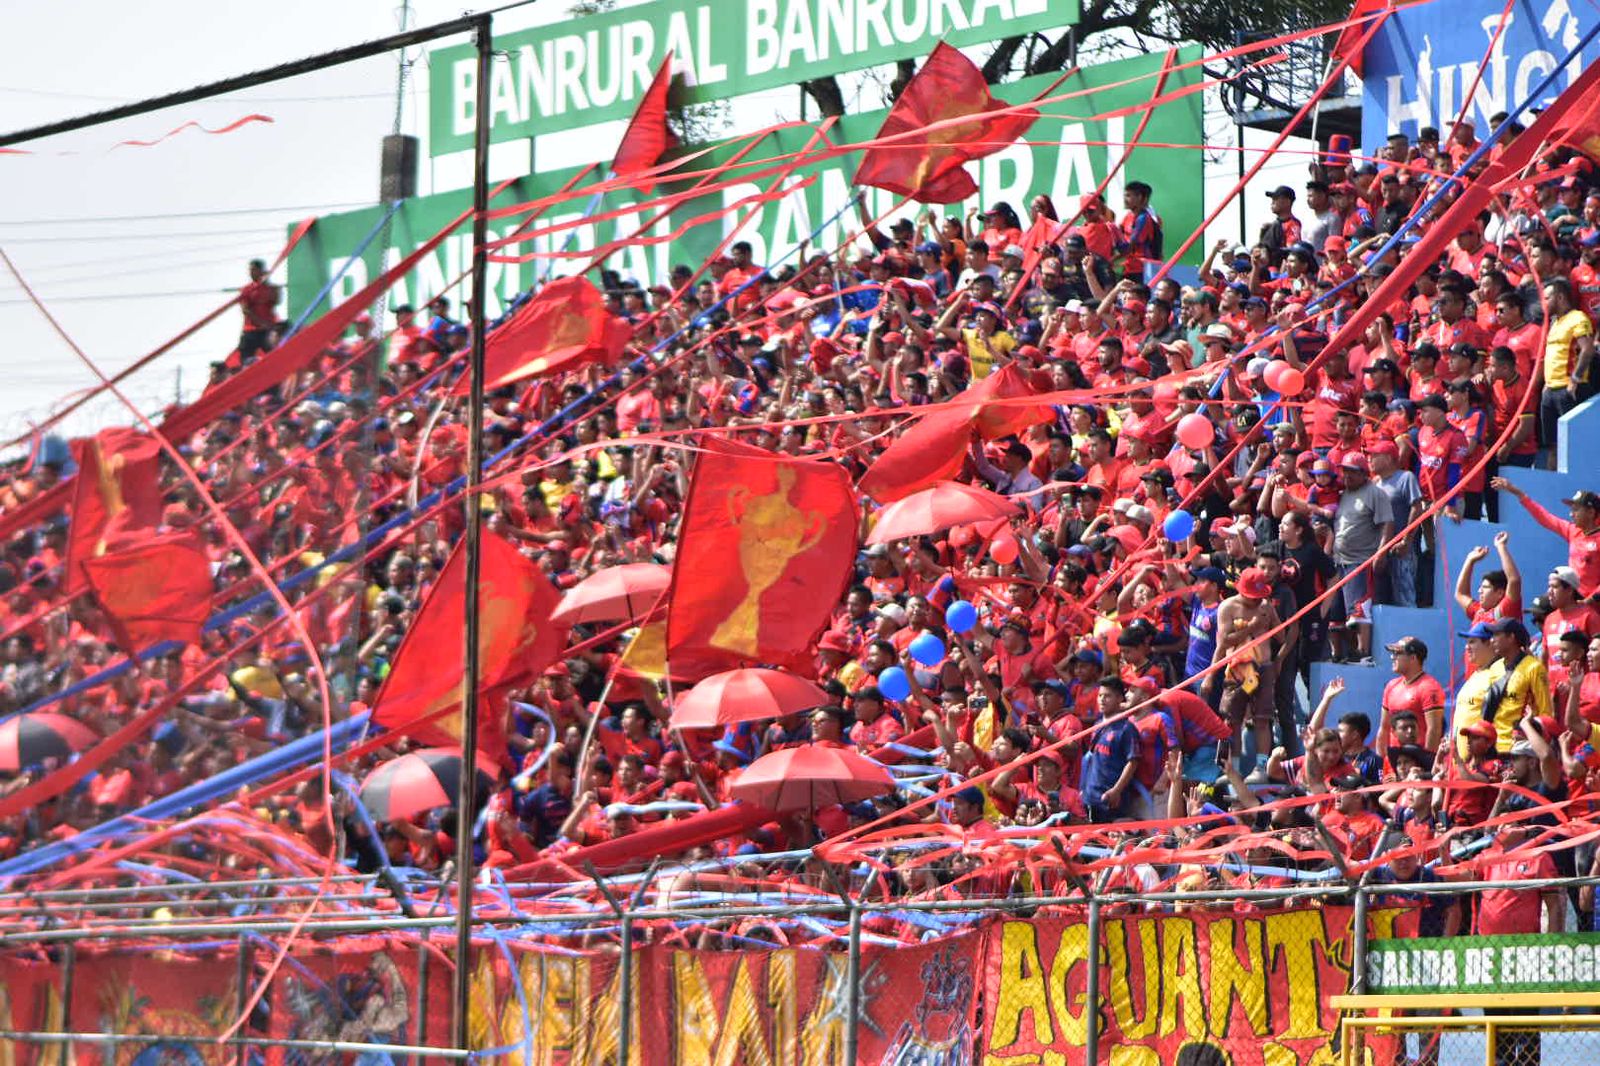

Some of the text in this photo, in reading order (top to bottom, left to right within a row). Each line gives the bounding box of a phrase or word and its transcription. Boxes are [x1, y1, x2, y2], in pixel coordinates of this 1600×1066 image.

[453, 0, 1048, 137] BANRURAL BANRU
[1366, 948, 1458, 987] SALIDA
[1466, 946, 1495, 985] DE
